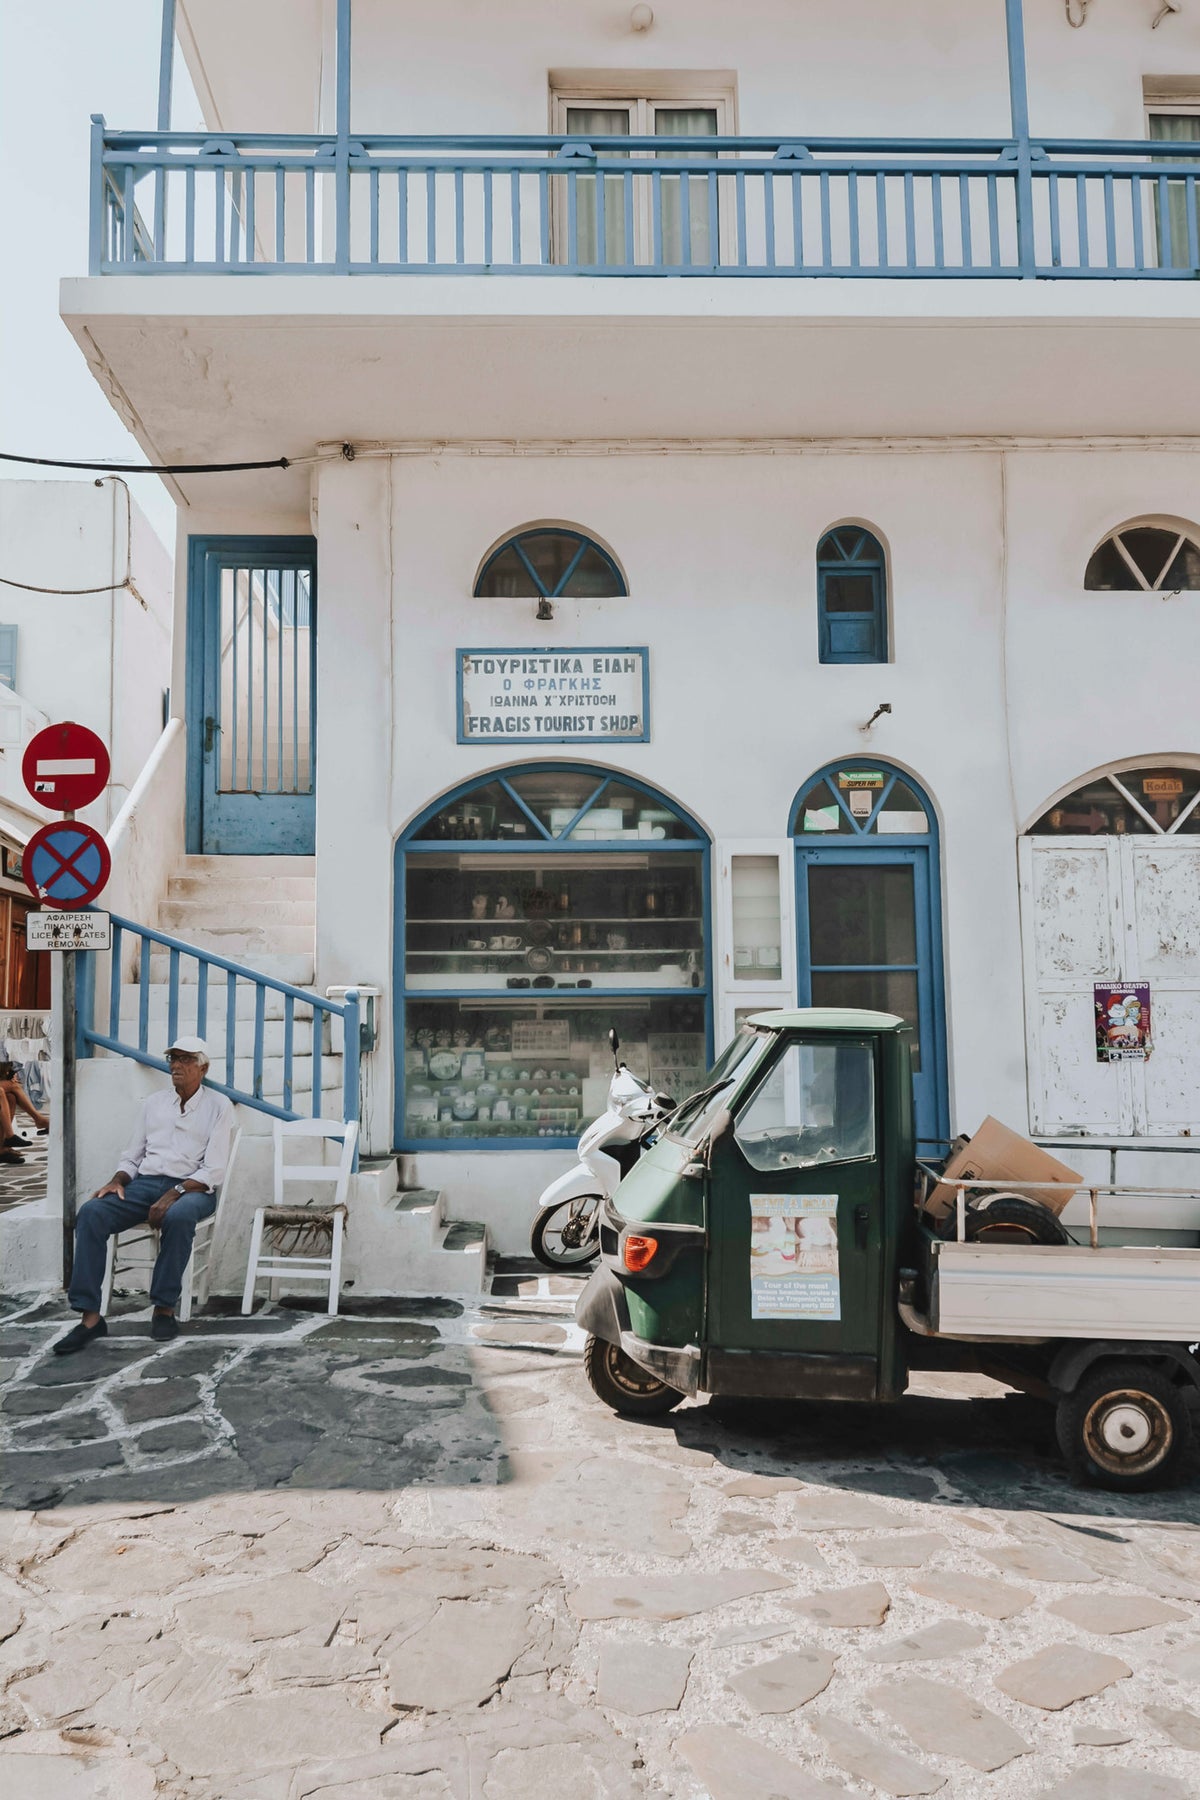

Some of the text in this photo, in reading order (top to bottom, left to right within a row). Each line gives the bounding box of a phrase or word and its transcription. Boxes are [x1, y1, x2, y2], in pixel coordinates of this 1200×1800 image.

[471, 658, 636, 674] ΤΟΥΡΙΣΤΙΚΑ ΕΙΔΗ
[503, 677, 602, 691] Ο ΦΡΑΓΚΗΣ
[490, 695, 538, 707] ΙΩΑΝΝΑ
[469, 714, 639, 733] FRAGIS TOURIST SHOP
[1145, 781, 1182, 791] Kodak
[47, 940, 91, 948] REMOVAL
[789, 1198, 799, 1209] A
[763, 1281, 782, 1289] Tour
